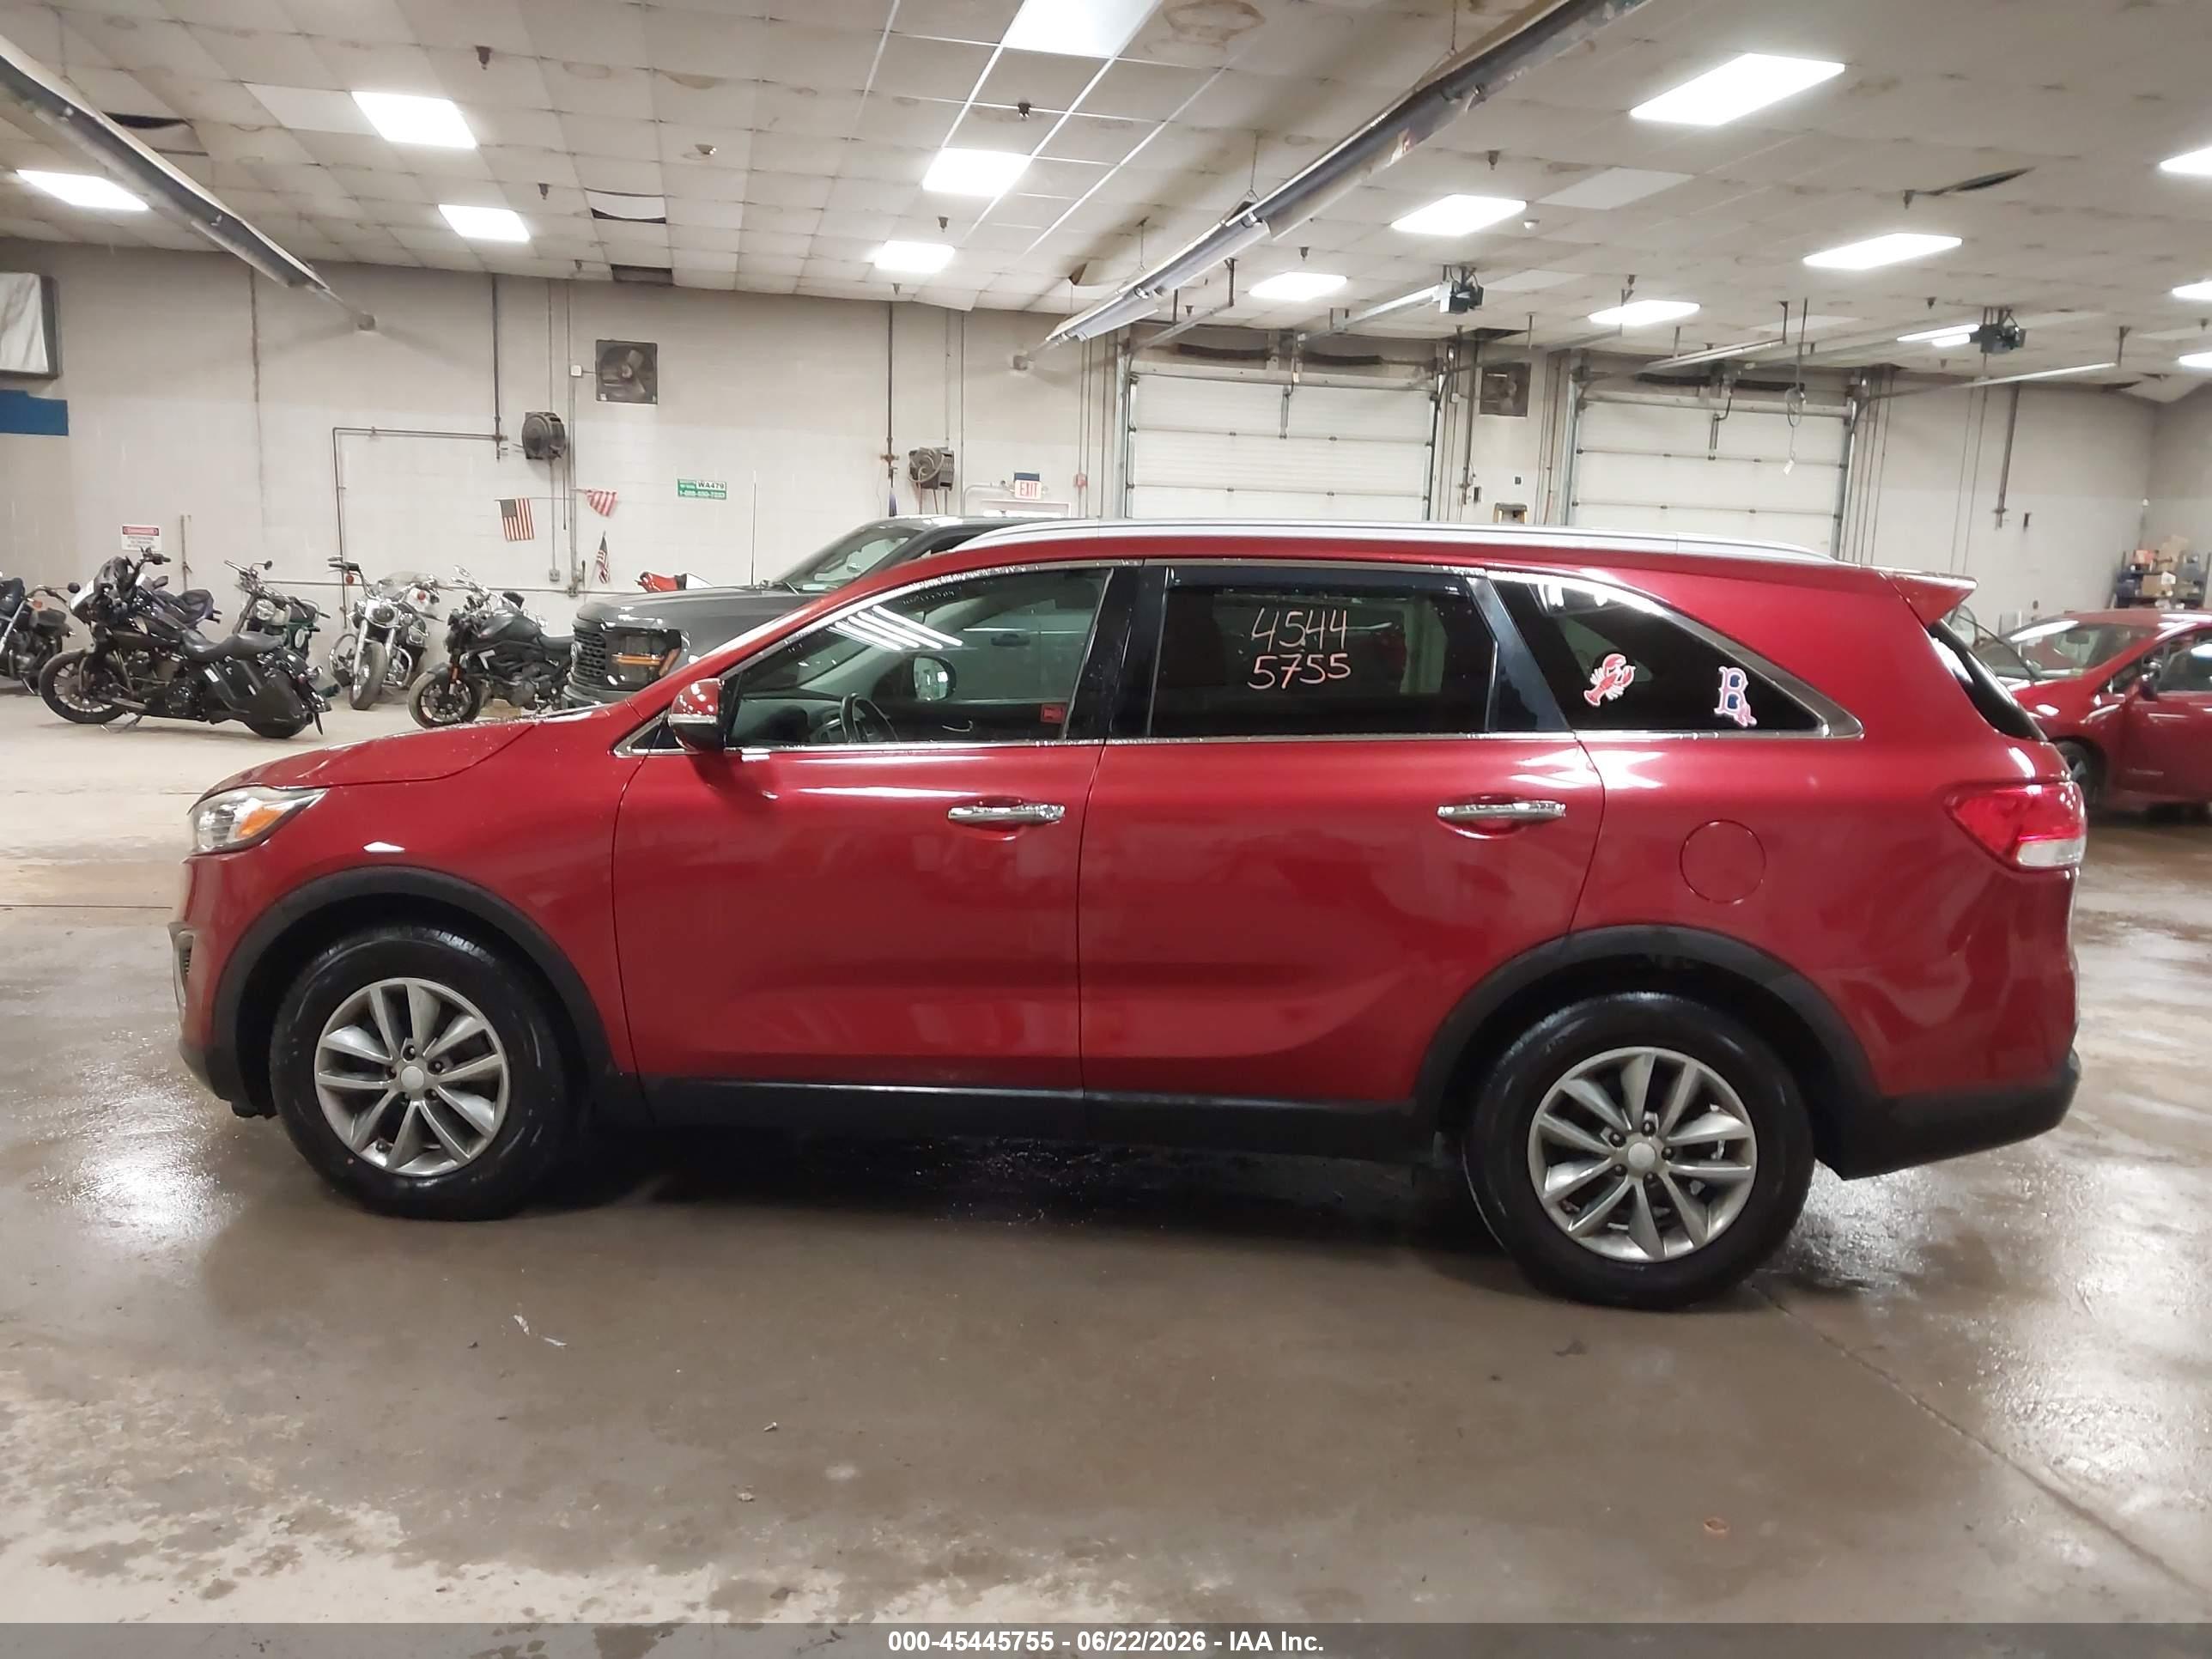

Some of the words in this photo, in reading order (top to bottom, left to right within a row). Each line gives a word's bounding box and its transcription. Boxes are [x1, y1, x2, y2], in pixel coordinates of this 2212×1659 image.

[1019, 481, 1039, 497] EXIT
[1250, 607, 1348, 653] 4544
[1247, 653, 1352, 690] 5755
